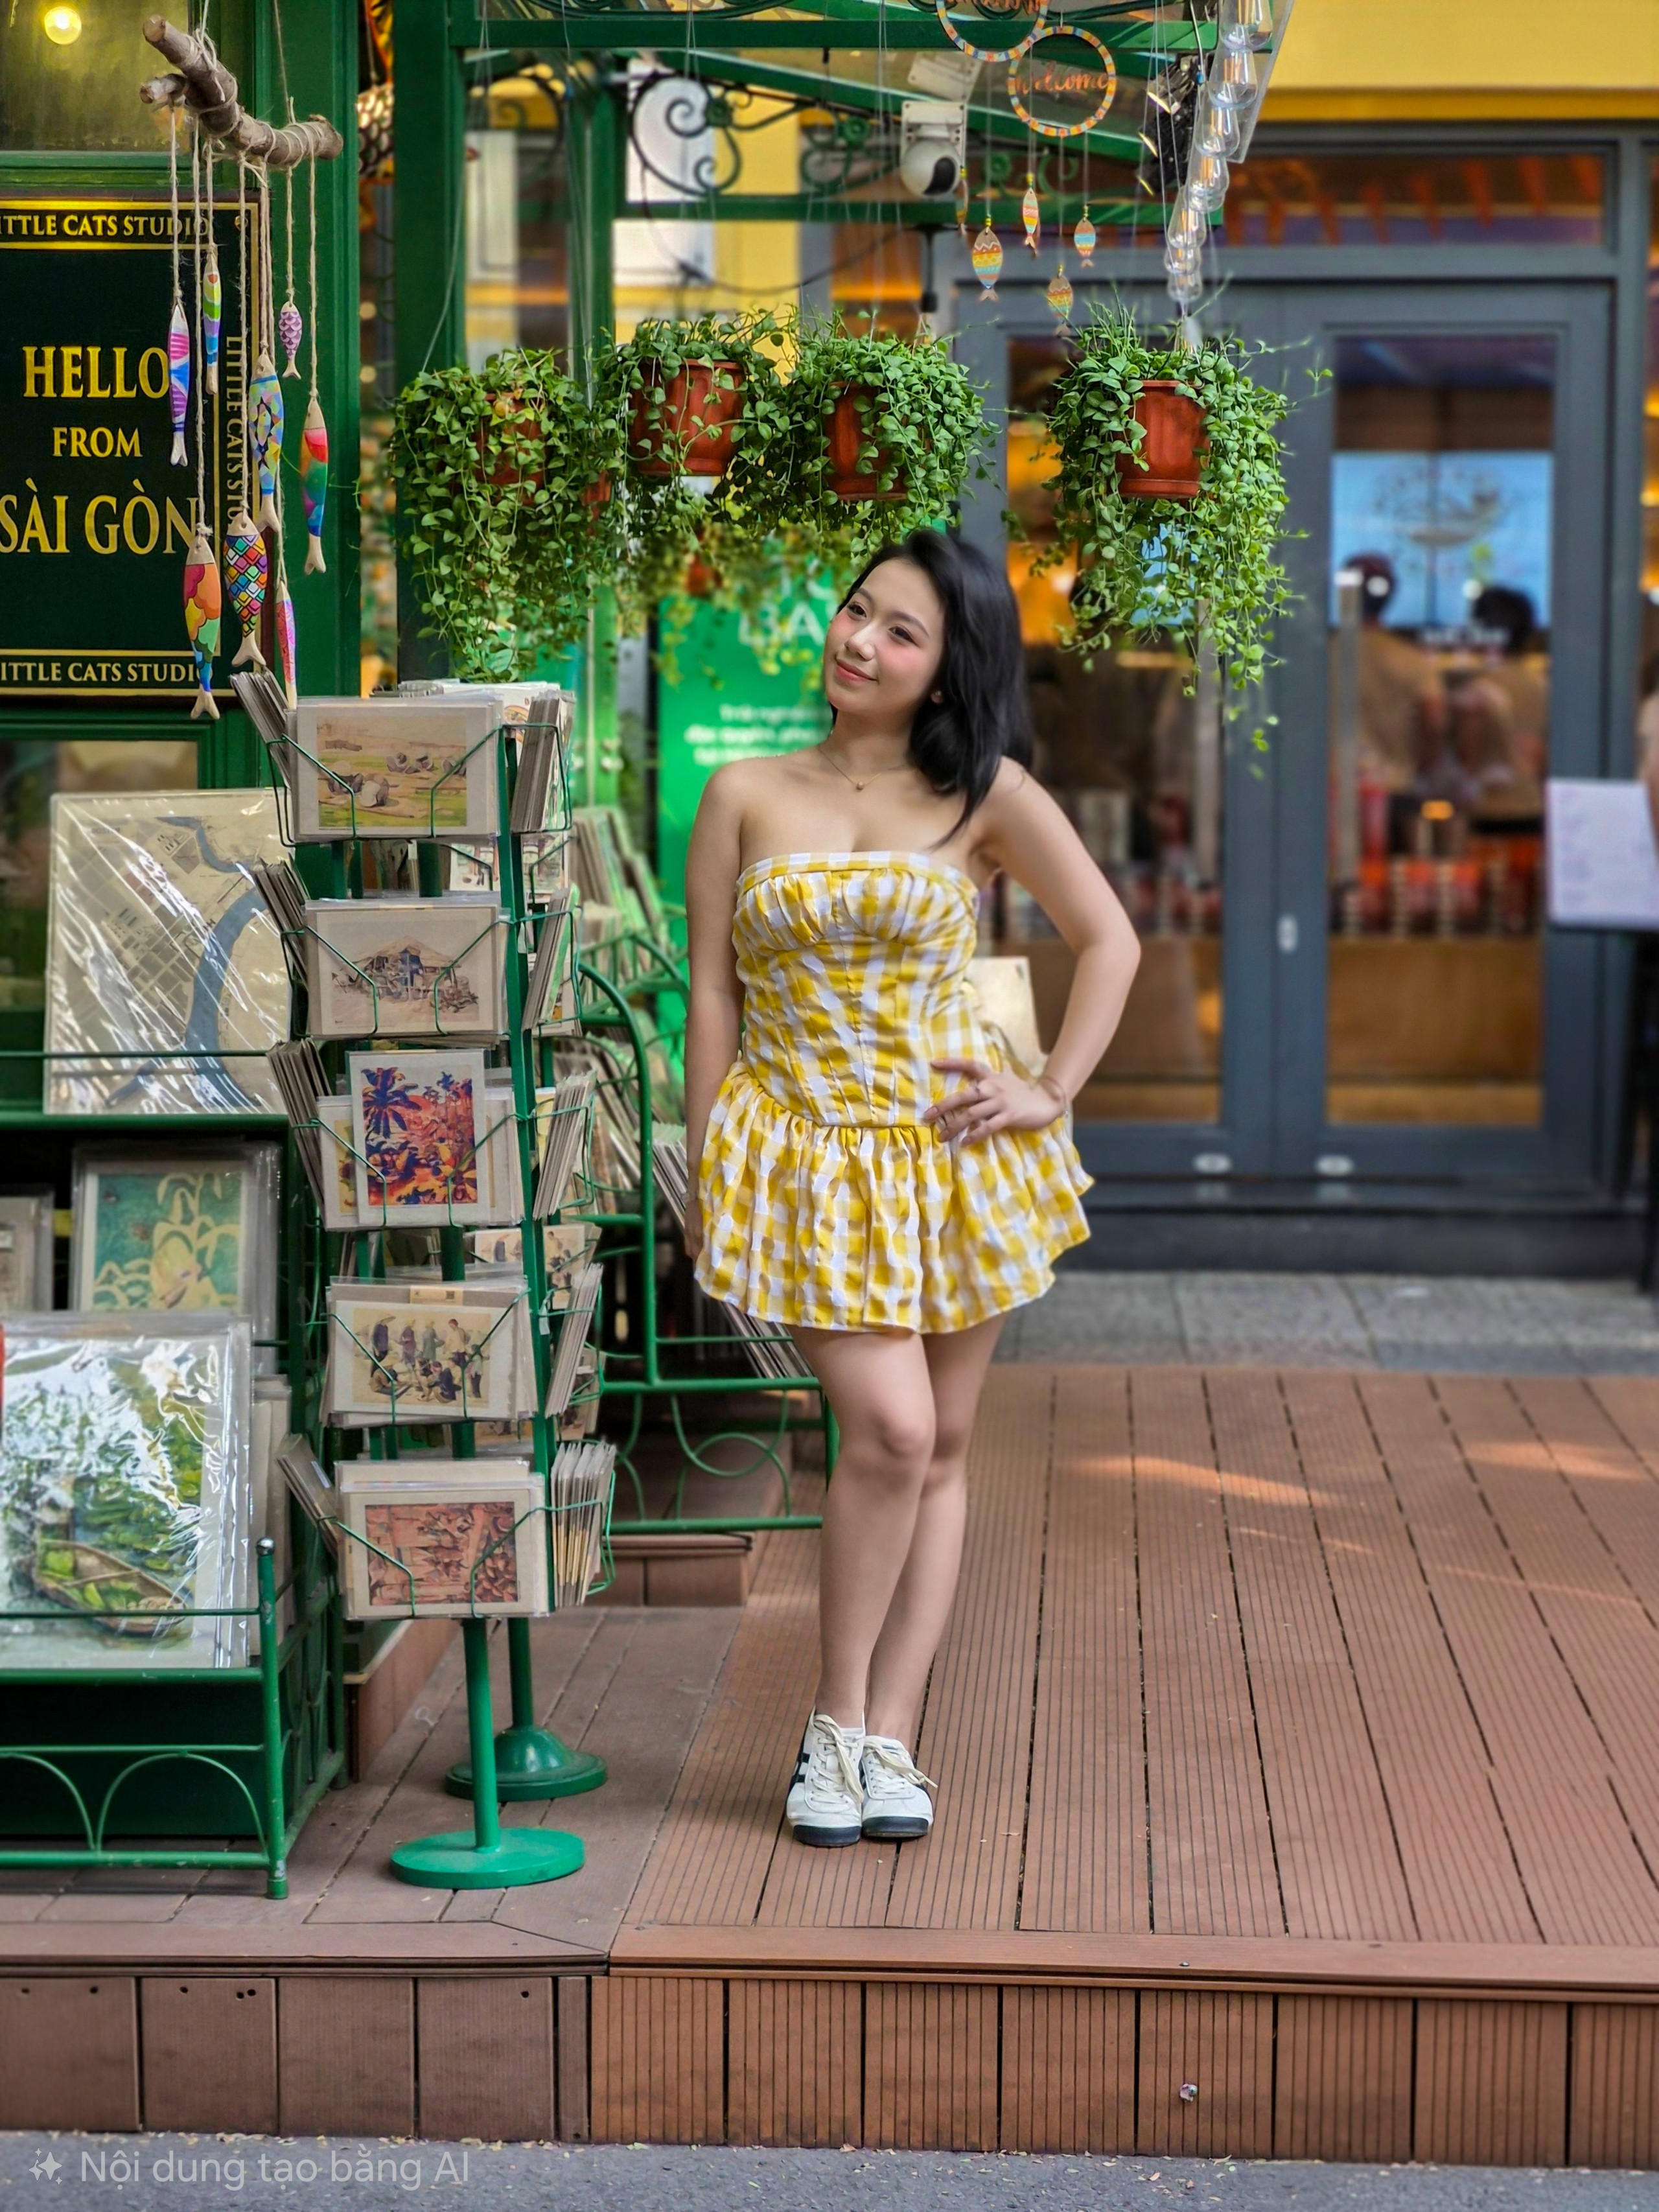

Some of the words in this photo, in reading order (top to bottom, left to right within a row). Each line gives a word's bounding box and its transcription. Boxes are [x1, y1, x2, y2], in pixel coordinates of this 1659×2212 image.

[0, 215, 57, 235] TTLE
[64, 215, 118, 236] CATS
[123, 215, 209, 236] STUDIO
[22, 346, 170, 399] HELLO
[52, 427, 143, 457] FROM
[0, 477, 70, 553] SÀI
[85, 478, 198, 555] GÒN
[67, 662, 122, 682] CATS
